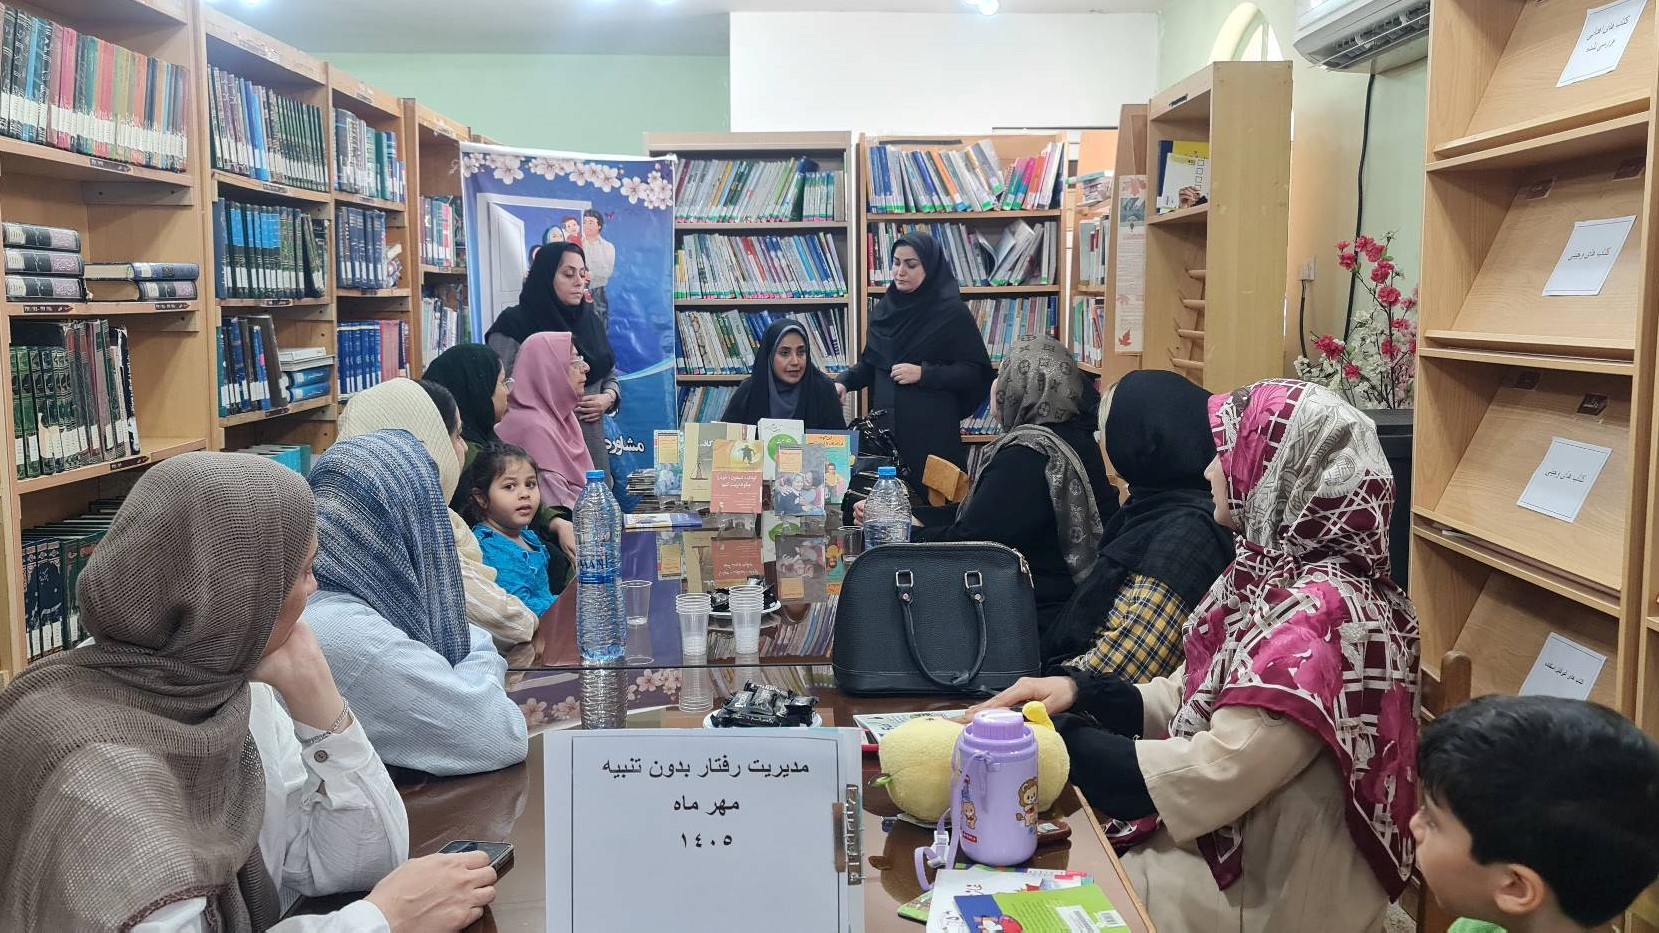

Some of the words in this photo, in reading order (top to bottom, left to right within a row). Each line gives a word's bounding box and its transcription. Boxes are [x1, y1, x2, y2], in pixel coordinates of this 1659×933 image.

[601, 757, 642, 779] تنبیه
[648, 760, 691, 778] بدون
[697, 754, 742, 778] رفتار
[747, 758, 810, 778] مدیریت
[673, 795, 699, 811] ماه
[704, 798, 740, 816] مهر
